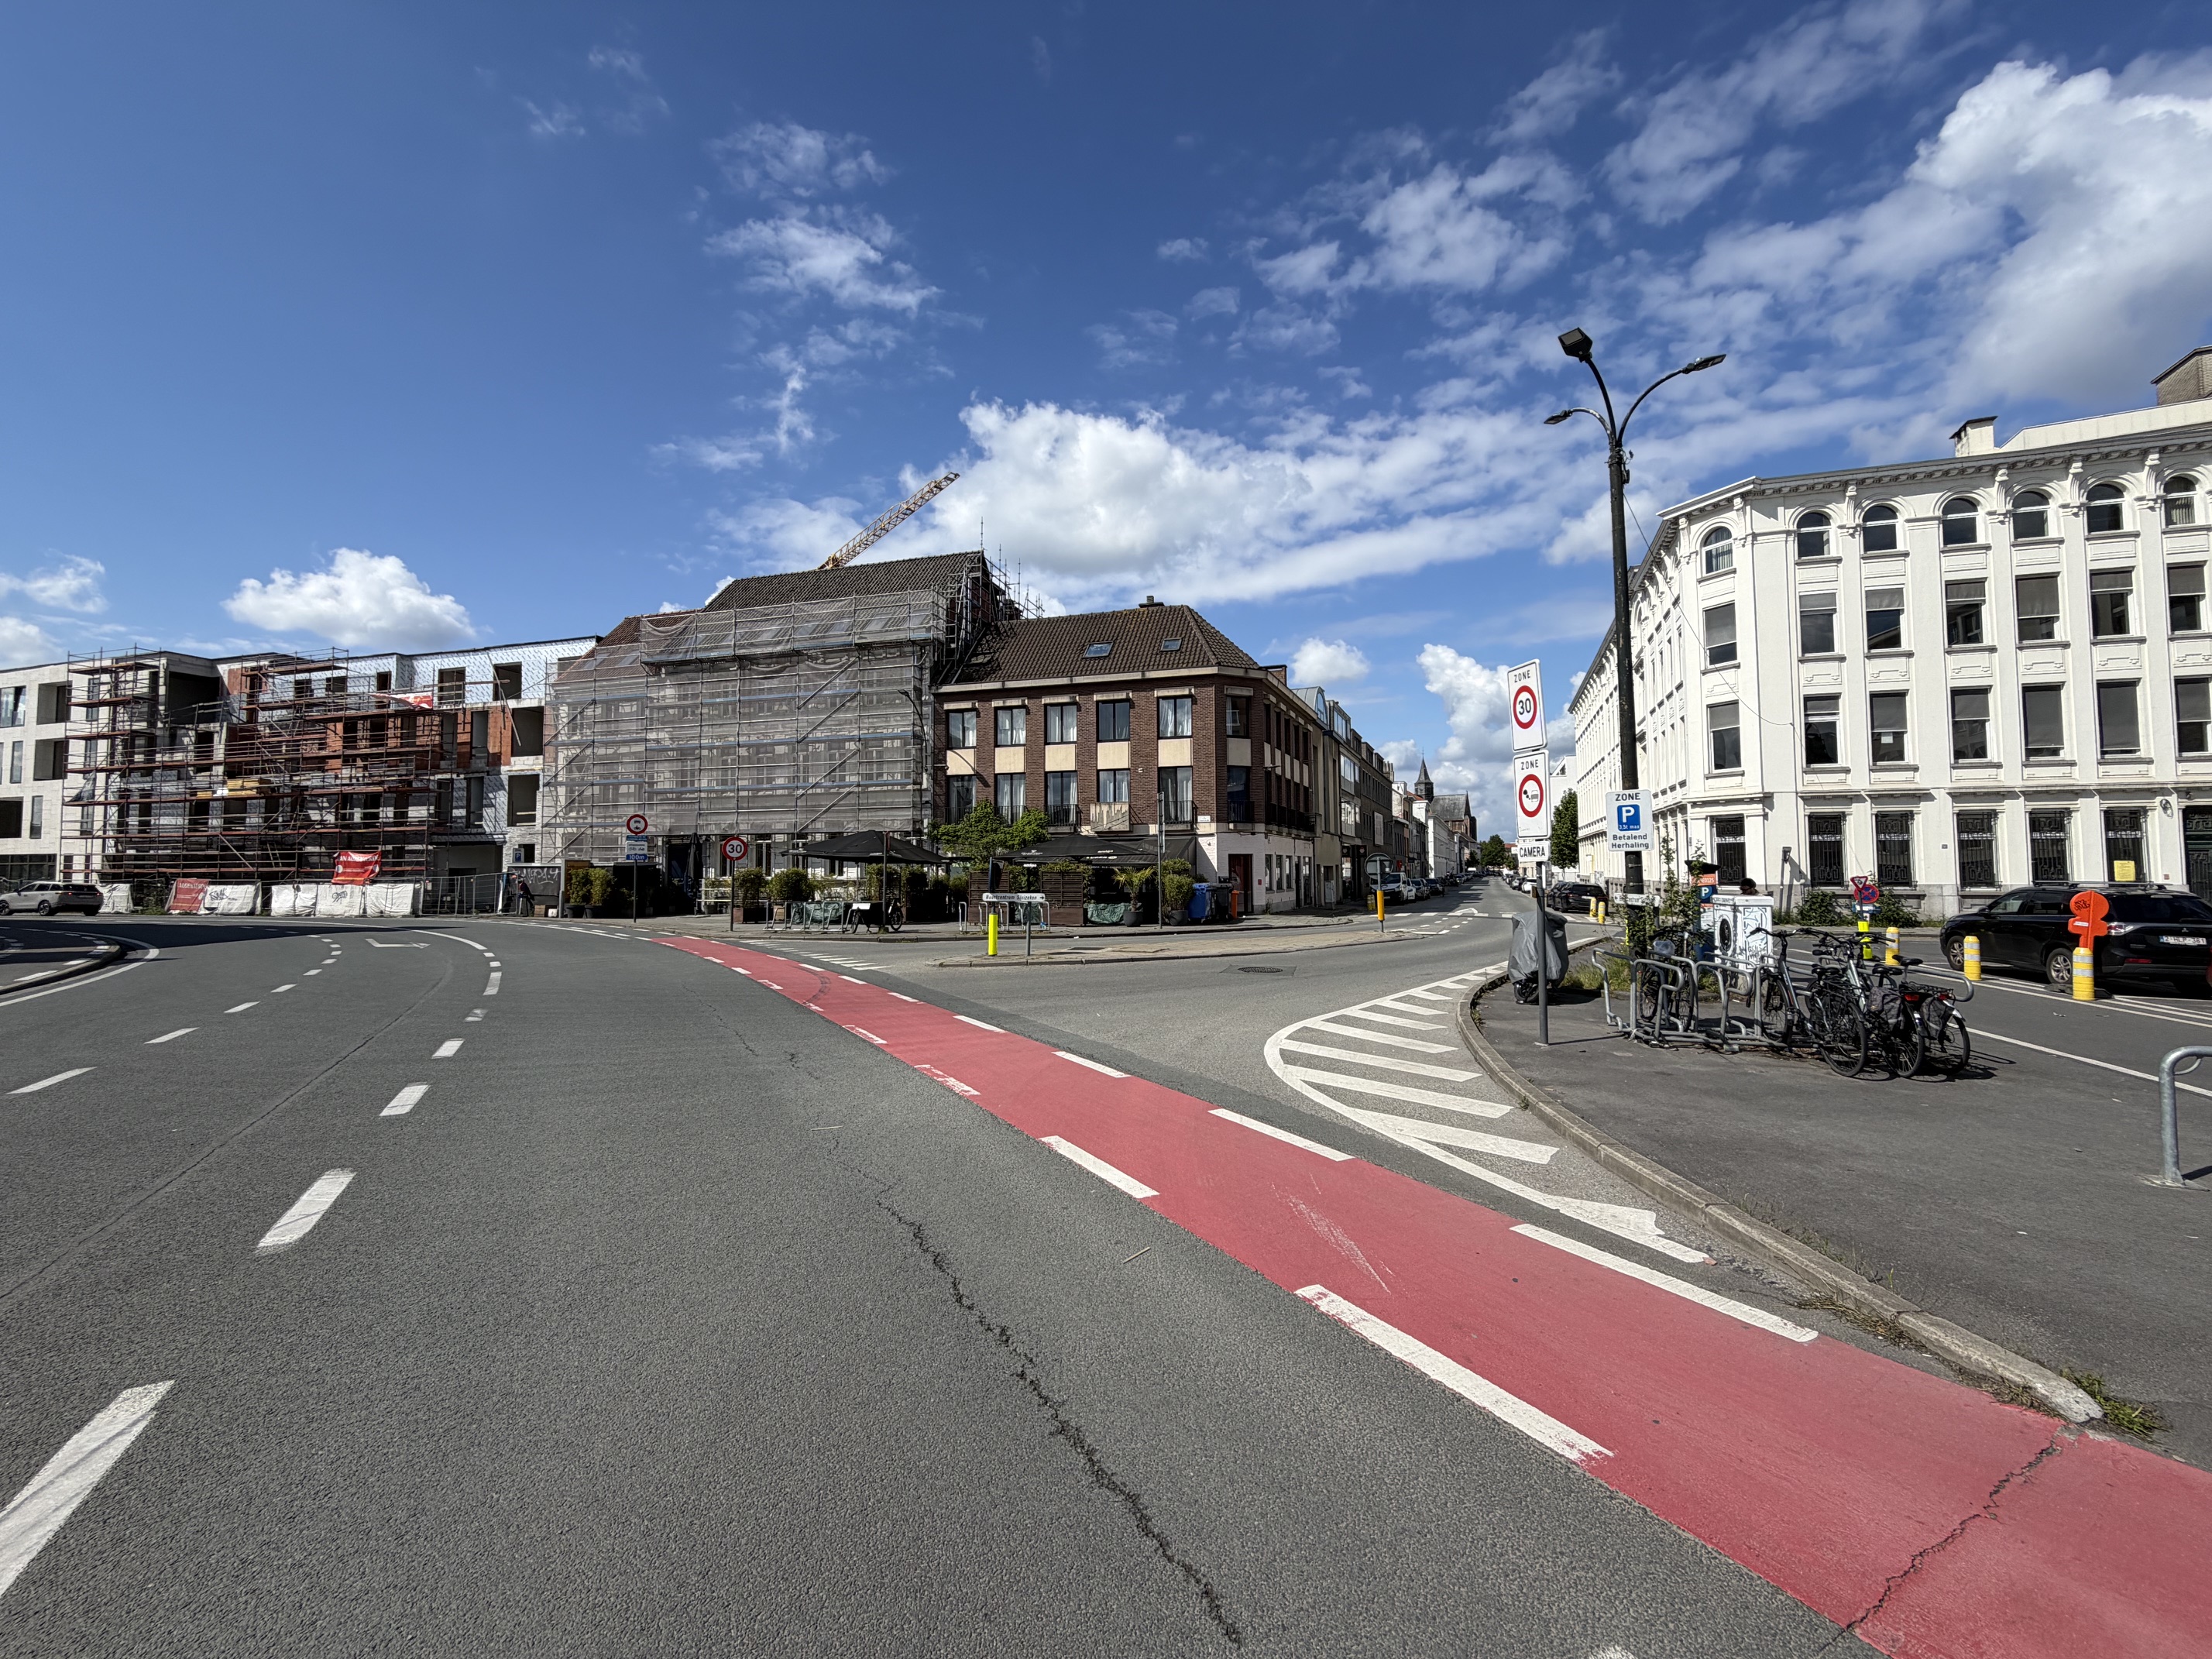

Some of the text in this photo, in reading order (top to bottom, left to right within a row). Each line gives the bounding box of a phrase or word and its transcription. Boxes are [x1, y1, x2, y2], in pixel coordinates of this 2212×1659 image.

[1513, 670, 1531, 683] ZONE
[1518, 698, 1532, 716] 30
[1520, 759, 1539, 771] ZONE
[1615, 792, 1641, 802] ZONE
[1621, 806, 1635, 823] P
[728, 843, 743, 854] 30
[1611, 841, 1650, 850] Herhaling
[1519, 846, 1546, 857] CAMERA
[1702, 887, 1709, 897] P
